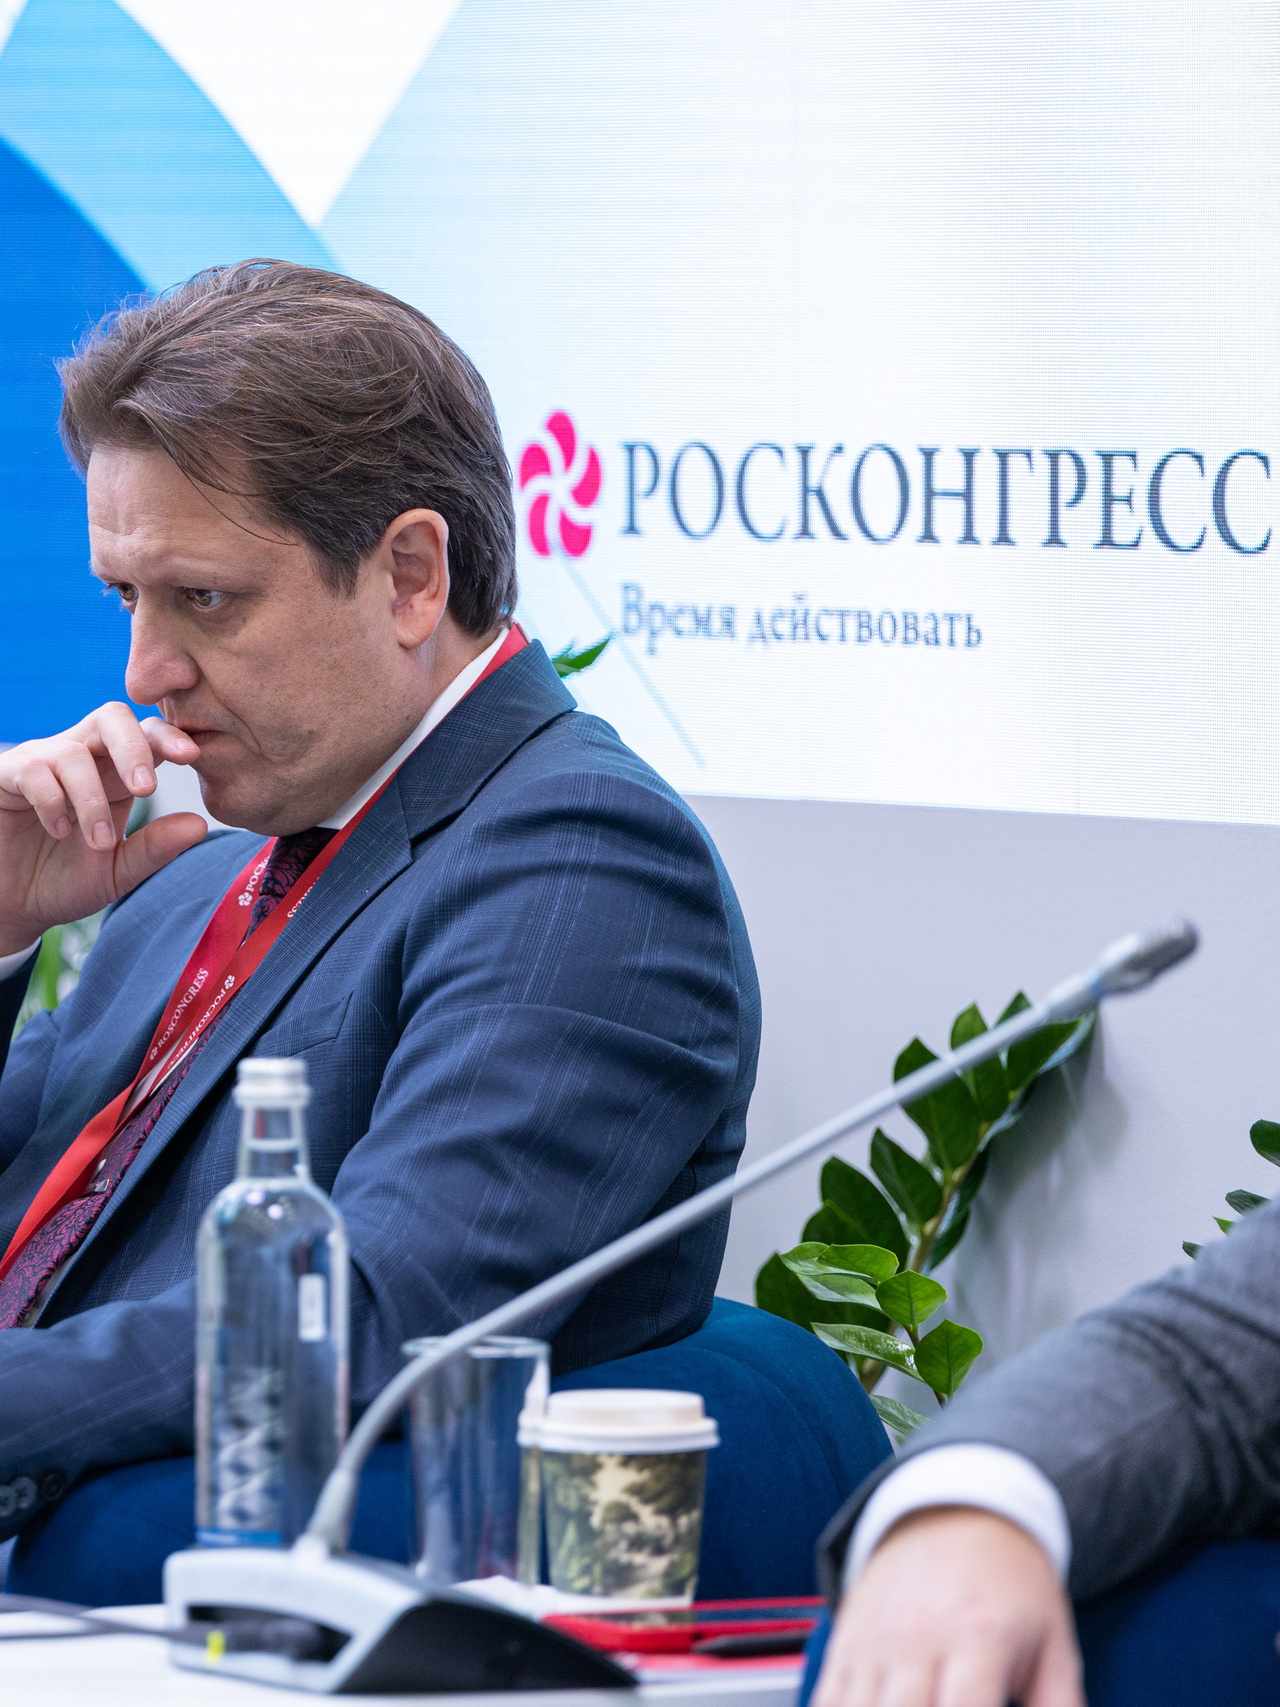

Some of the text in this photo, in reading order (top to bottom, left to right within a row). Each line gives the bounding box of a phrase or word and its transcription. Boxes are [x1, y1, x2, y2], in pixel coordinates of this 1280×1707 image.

[621, 441, 1273, 555] РОСКОНГРЕСС
[621, 581, 983, 656] Время действовать
[158, 968, 209, 1047] ROSCONGRESS
